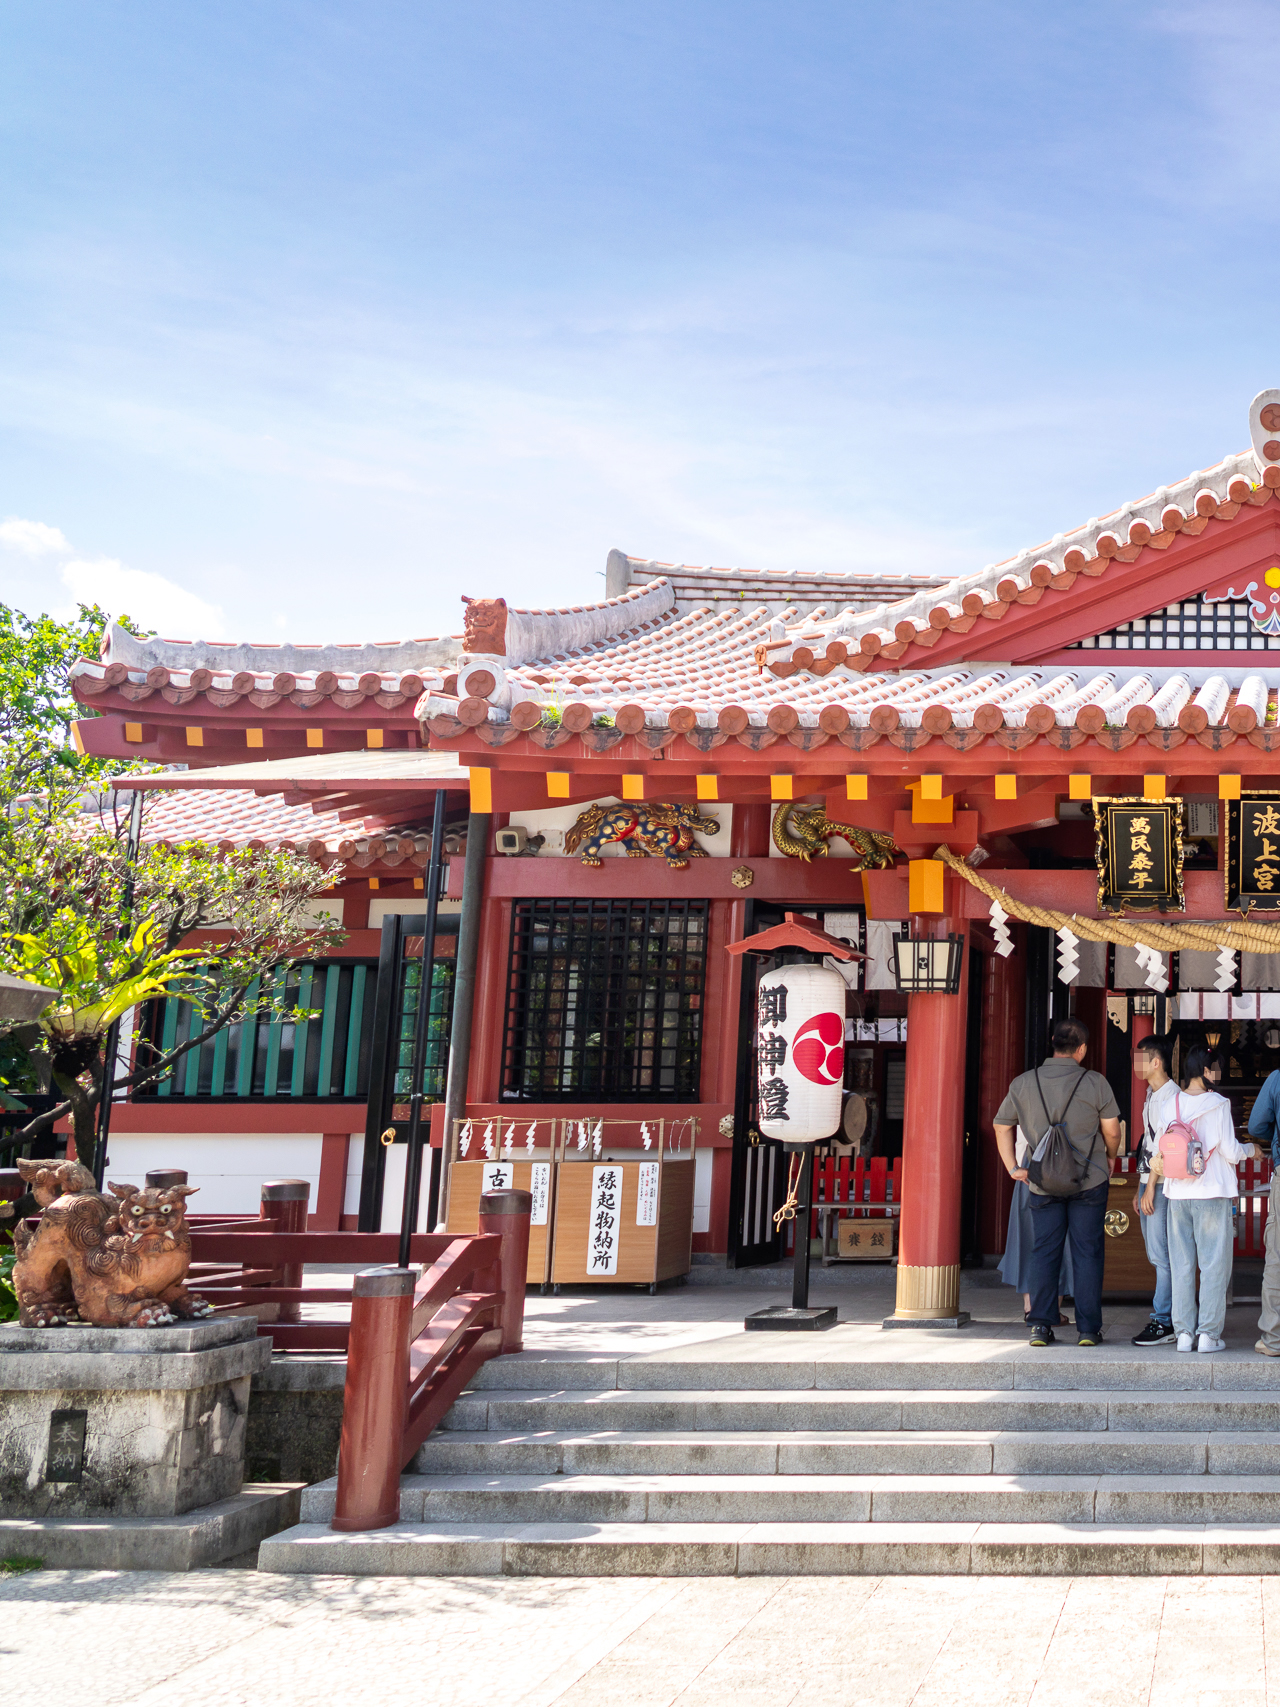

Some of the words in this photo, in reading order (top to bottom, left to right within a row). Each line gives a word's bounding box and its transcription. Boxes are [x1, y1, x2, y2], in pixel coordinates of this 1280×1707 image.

[1128, 816, 1154, 889] 萬民泰平
[489, 1168, 508, 1190] 古
[592, 1171, 617, 1270] 縁起物納所
[52, 1421, 79, 1471] 奉納
